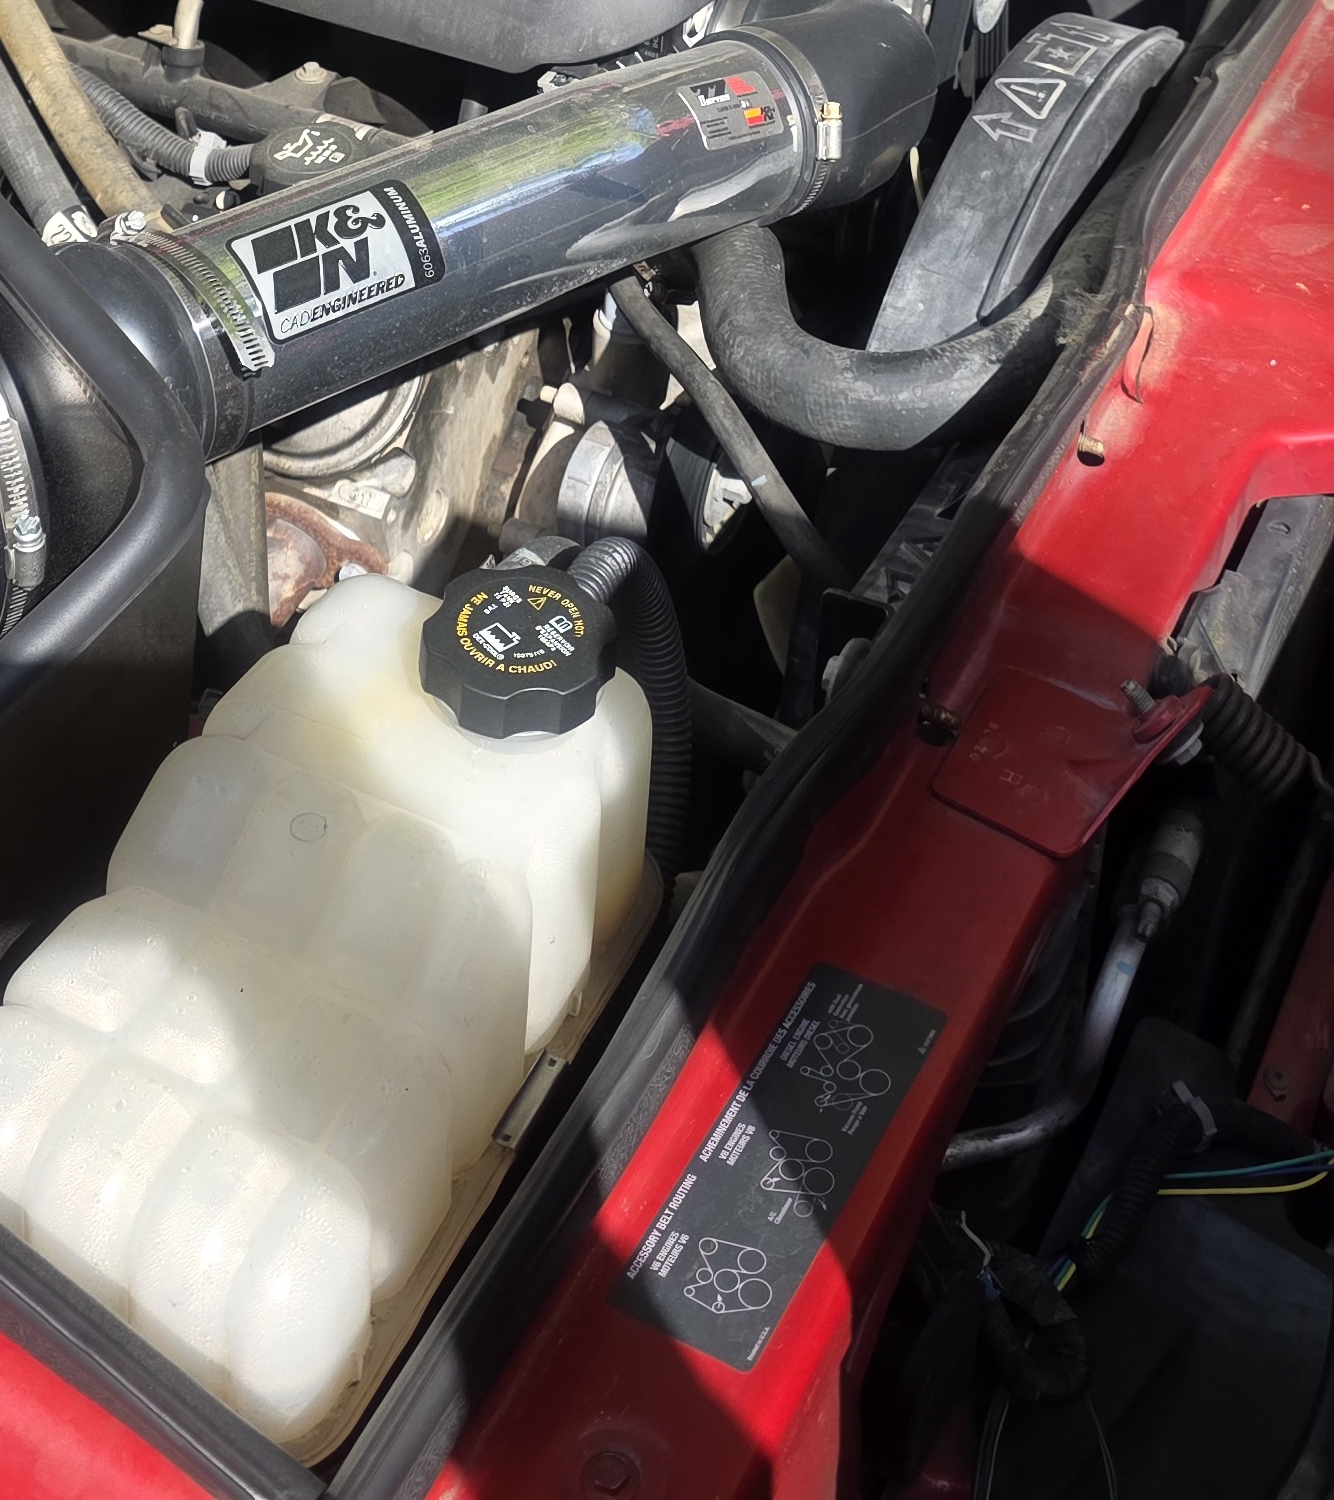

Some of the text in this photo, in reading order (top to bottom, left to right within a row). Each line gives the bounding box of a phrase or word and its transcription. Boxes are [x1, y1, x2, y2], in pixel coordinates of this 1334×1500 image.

[470, 591, 489, 606] NE
[528, 584, 562, 601] NEVER
[560, 598, 582, 619] OPEN
[457, 603, 474, 637] JAMAIS
[460, 637, 494, 668] OUVRIR
[496, 663, 505, 672] A
[509, 660, 558, 674] CHAUD!
[699, 981, 816, 1163] ACHEMINEMENT DE LA COURROIE DES ACCESSOIRES
[718, 1122, 747, 1160] V8 ENGINES
[726, 1134, 751, 1167] MOTEURS
[627, 1173, 698, 1280] ACCESSORY BELT ROUTING
[650, 1230, 680, 1272] V6 ENGINES
[658, 1233, 690, 1278] MOTEURS V6
